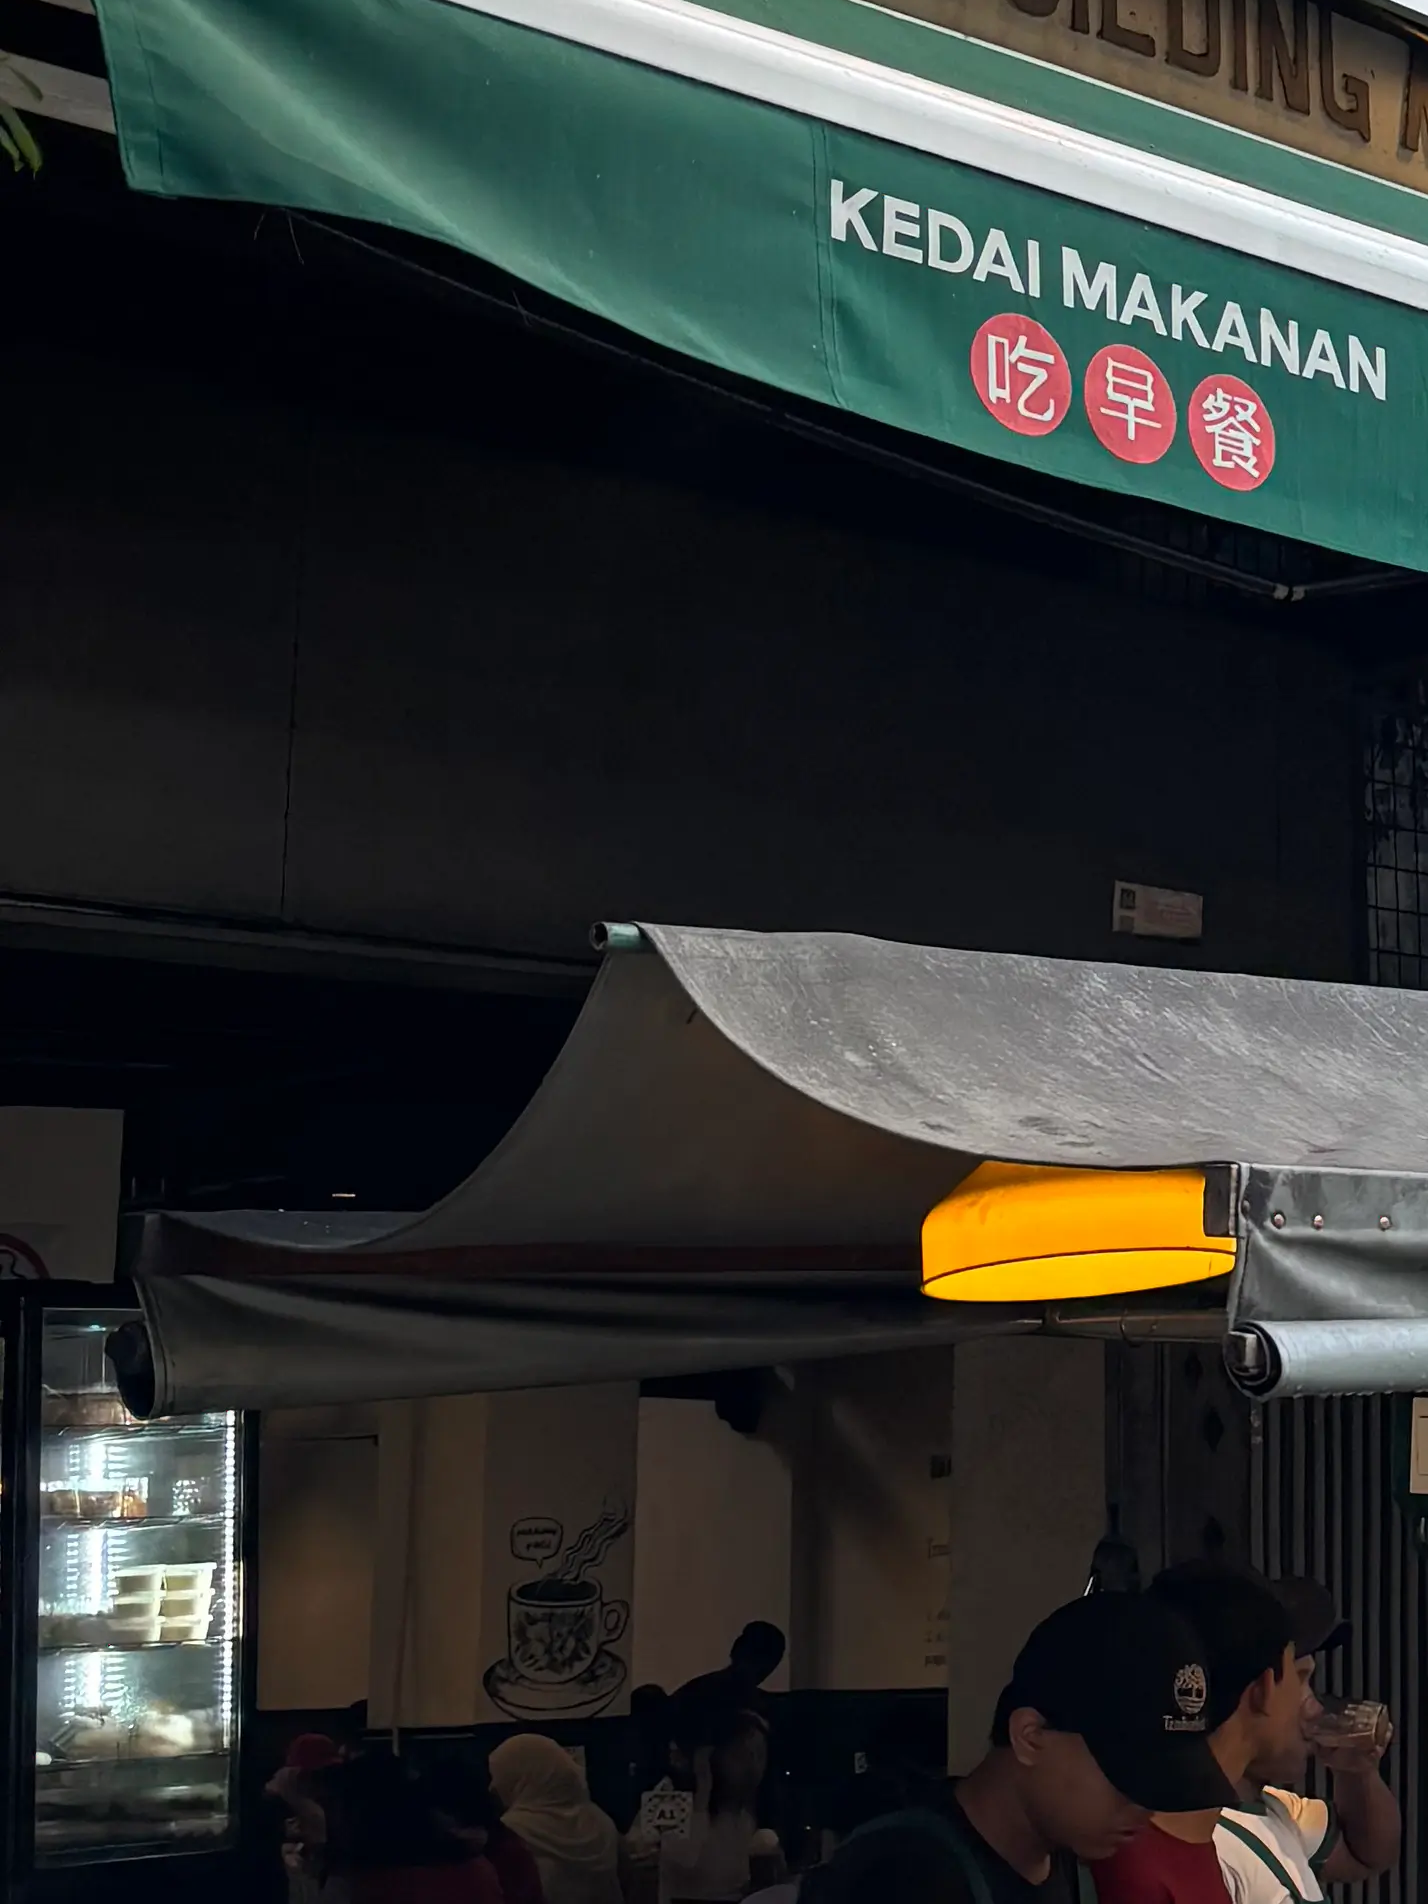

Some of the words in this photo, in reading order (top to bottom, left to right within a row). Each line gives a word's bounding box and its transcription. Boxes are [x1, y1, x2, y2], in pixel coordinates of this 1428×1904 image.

[829, 177, 1041, 299] KEDAI
[1061, 245, 1388, 402] MAKANAN
[986, 333, 1262, 481] 吃早餐
